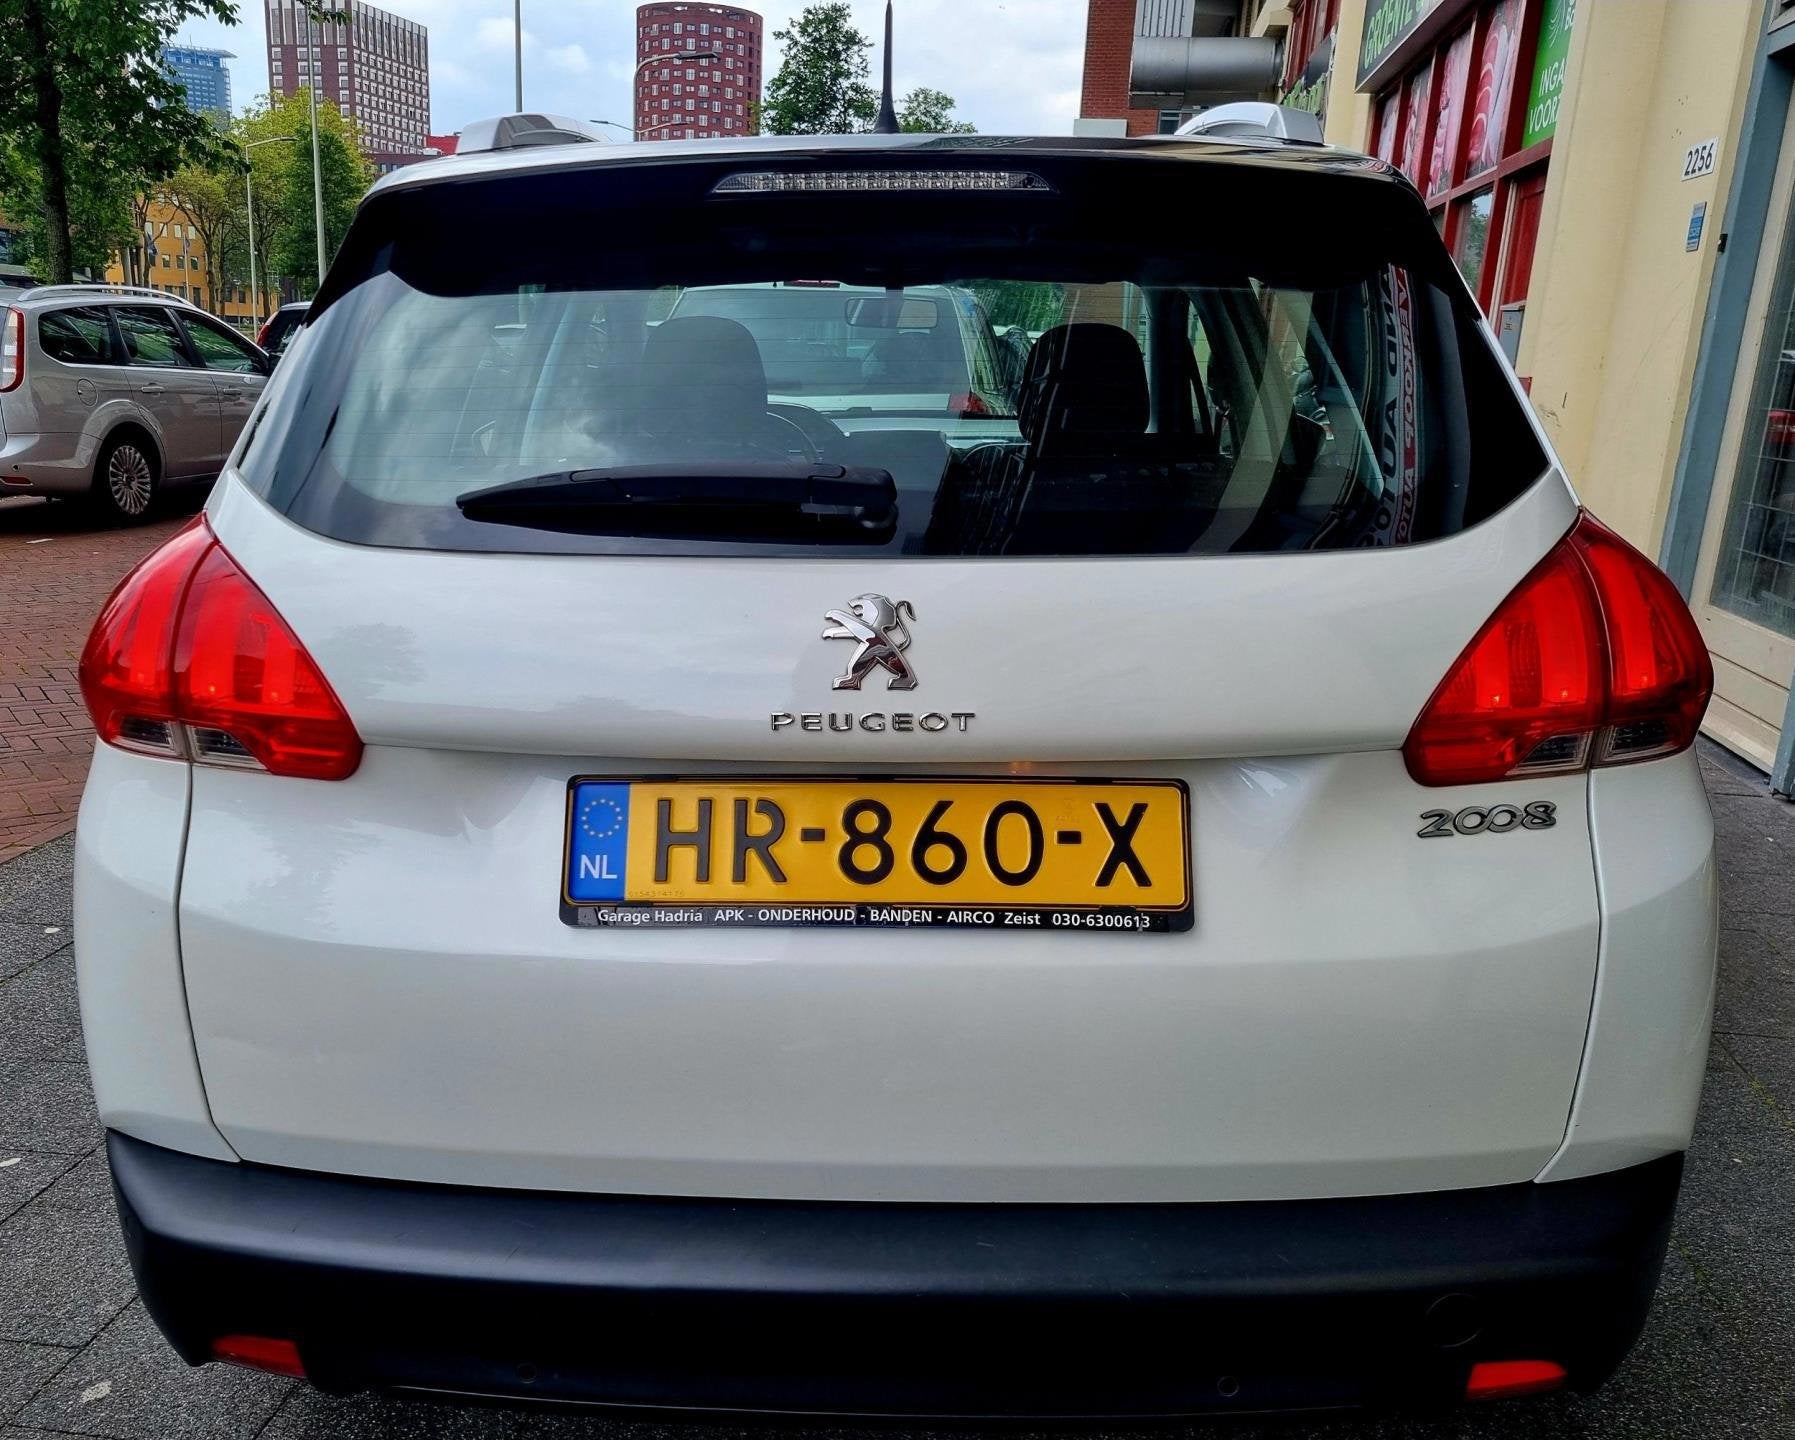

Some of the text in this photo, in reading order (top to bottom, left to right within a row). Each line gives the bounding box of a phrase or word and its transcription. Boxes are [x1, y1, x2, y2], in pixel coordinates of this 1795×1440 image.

[1684, 142, 1714, 176] 2256
[771, 712, 976, 732] PEUGEOT
[1417, 800, 1557, 838] 2008
[654, 798, 1153, 887] HR-860-X
[579, 854, 618, 879] NL
[598, 909, 650, 924] Garage
[655, 910, 703, 922] Hadria
[714, 910, 744, 921] APK
[758, 910, 855, 922] ONDERHOUD
[870, 910, 932, 923] BANDEN
[947, 911, 995, 924] AIRCO
[1004, 912, 1040, 925] Zeist
[1052, 912, 1150, 928] 030-6300613
